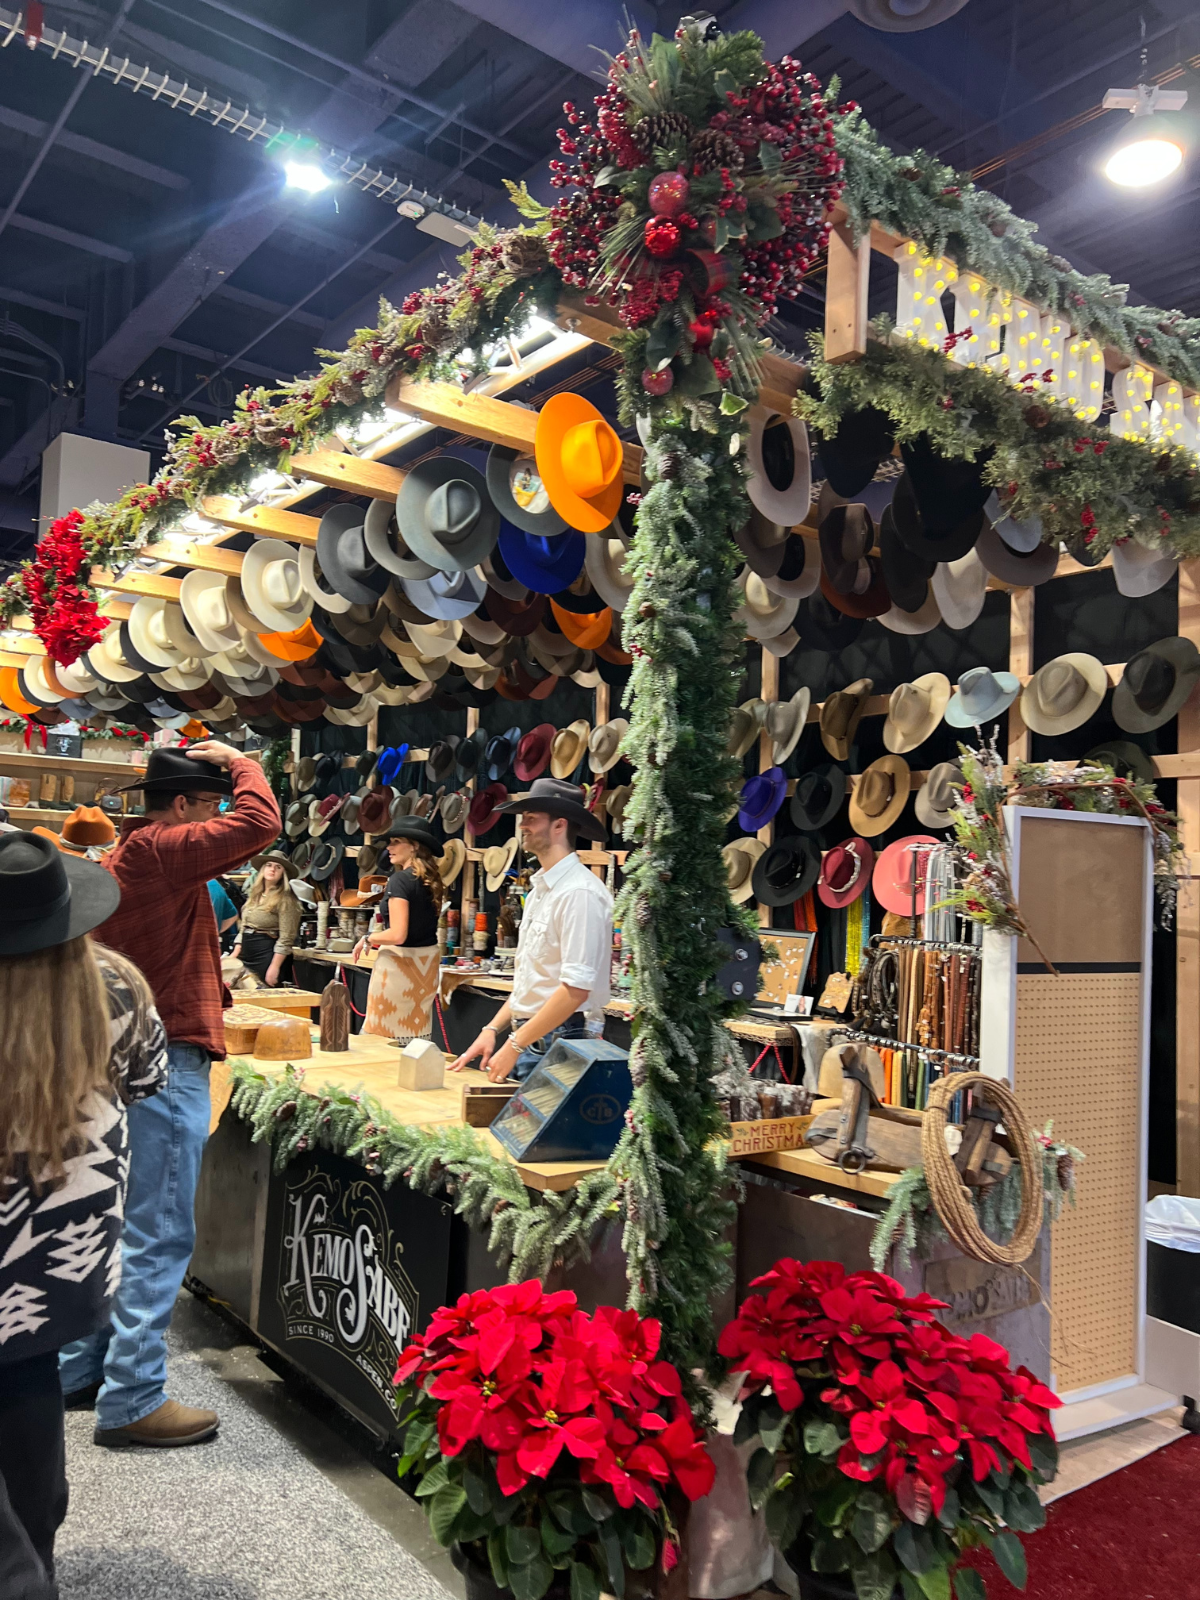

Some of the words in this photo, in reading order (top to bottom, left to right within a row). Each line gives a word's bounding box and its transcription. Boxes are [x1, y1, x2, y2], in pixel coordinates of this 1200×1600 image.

[889, 240, 1105, 424] KEMO
[750, 1122, 795, 1137] MERRY
[733, 1133, 811, 1153] CHRISTMA
[284, 1193, 355, 1319] KEMO
[288, 1325, 314, 1335] SINCE
[317, 1328, 335, 1343] 1990
